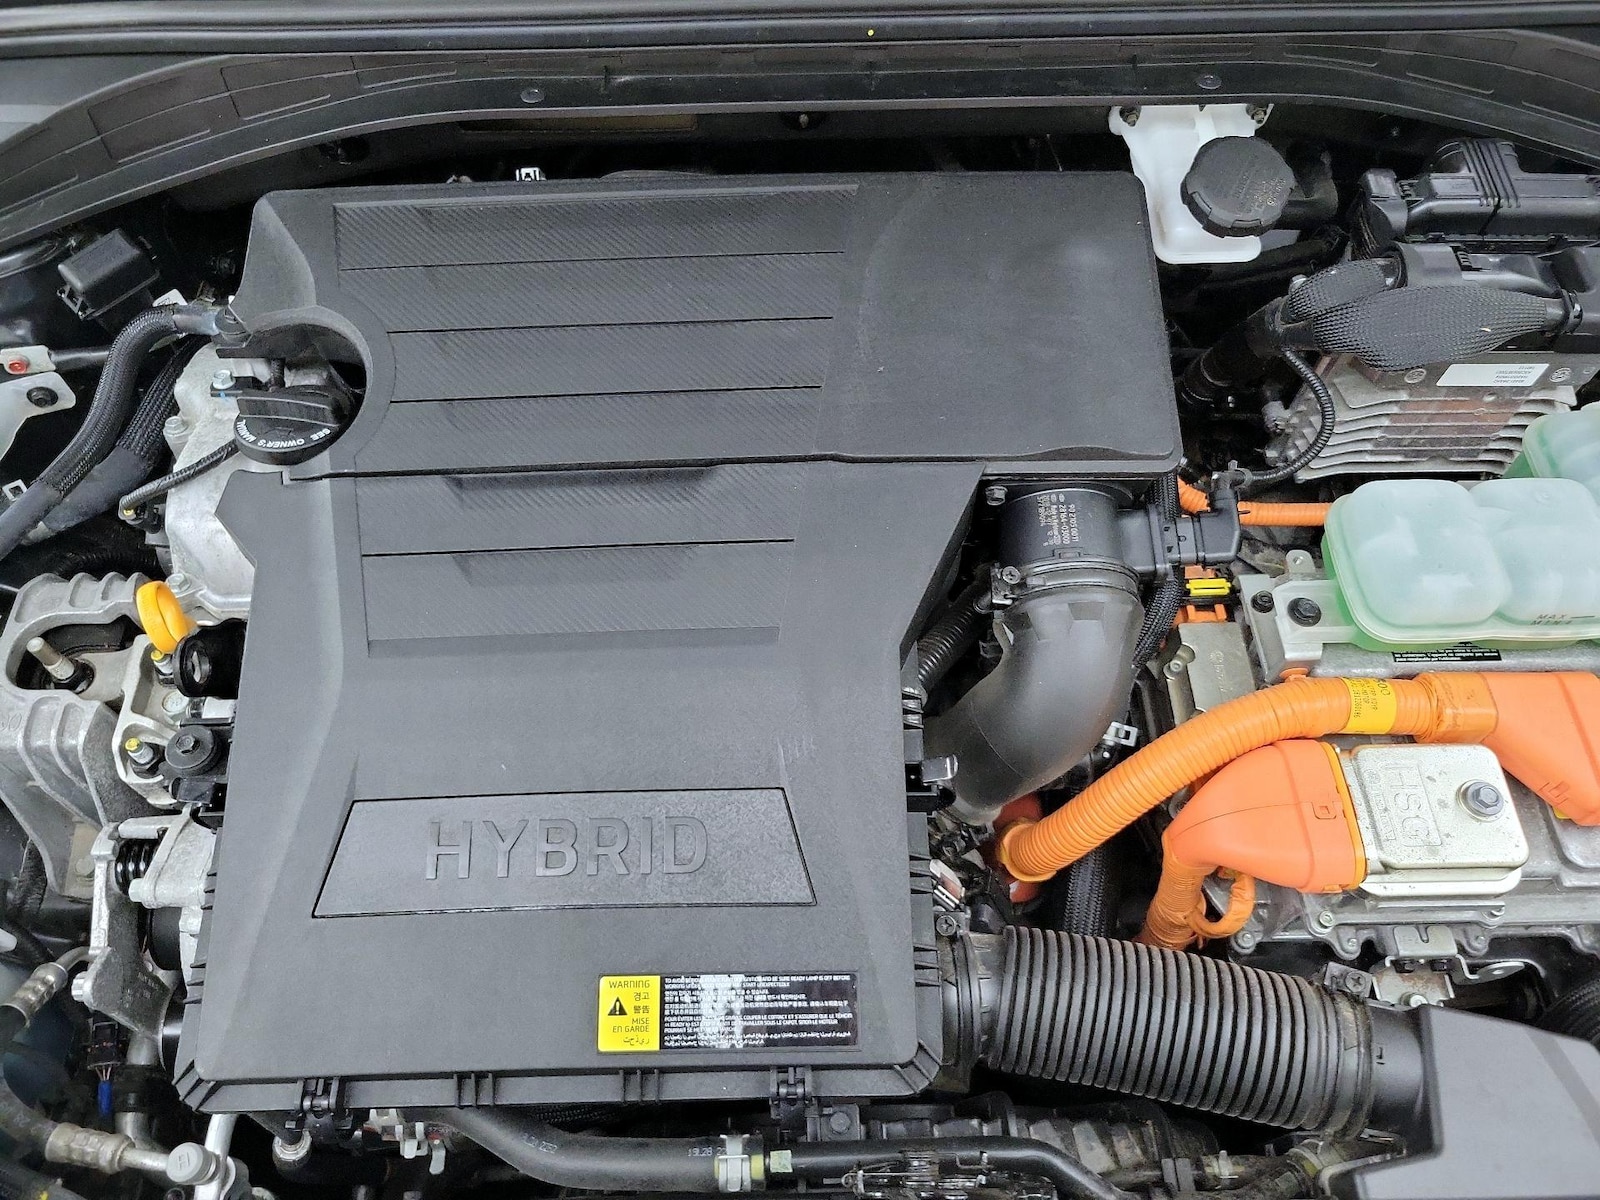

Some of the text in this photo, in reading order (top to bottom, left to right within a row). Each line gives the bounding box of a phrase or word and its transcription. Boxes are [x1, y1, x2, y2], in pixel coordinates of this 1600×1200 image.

[236, 419, 331, 448] SEE OWNER'S MANUAL
[1385, 764, 1430, 841] HSG
[426, 815, 709, 880] HYBRID
[608, 980, 650, 989] WARNING
[634, 992, 650, 1002] 경고
[632, 1017, 650, 1025] MISE
[625, 1025, 650, 1033] GARDE
